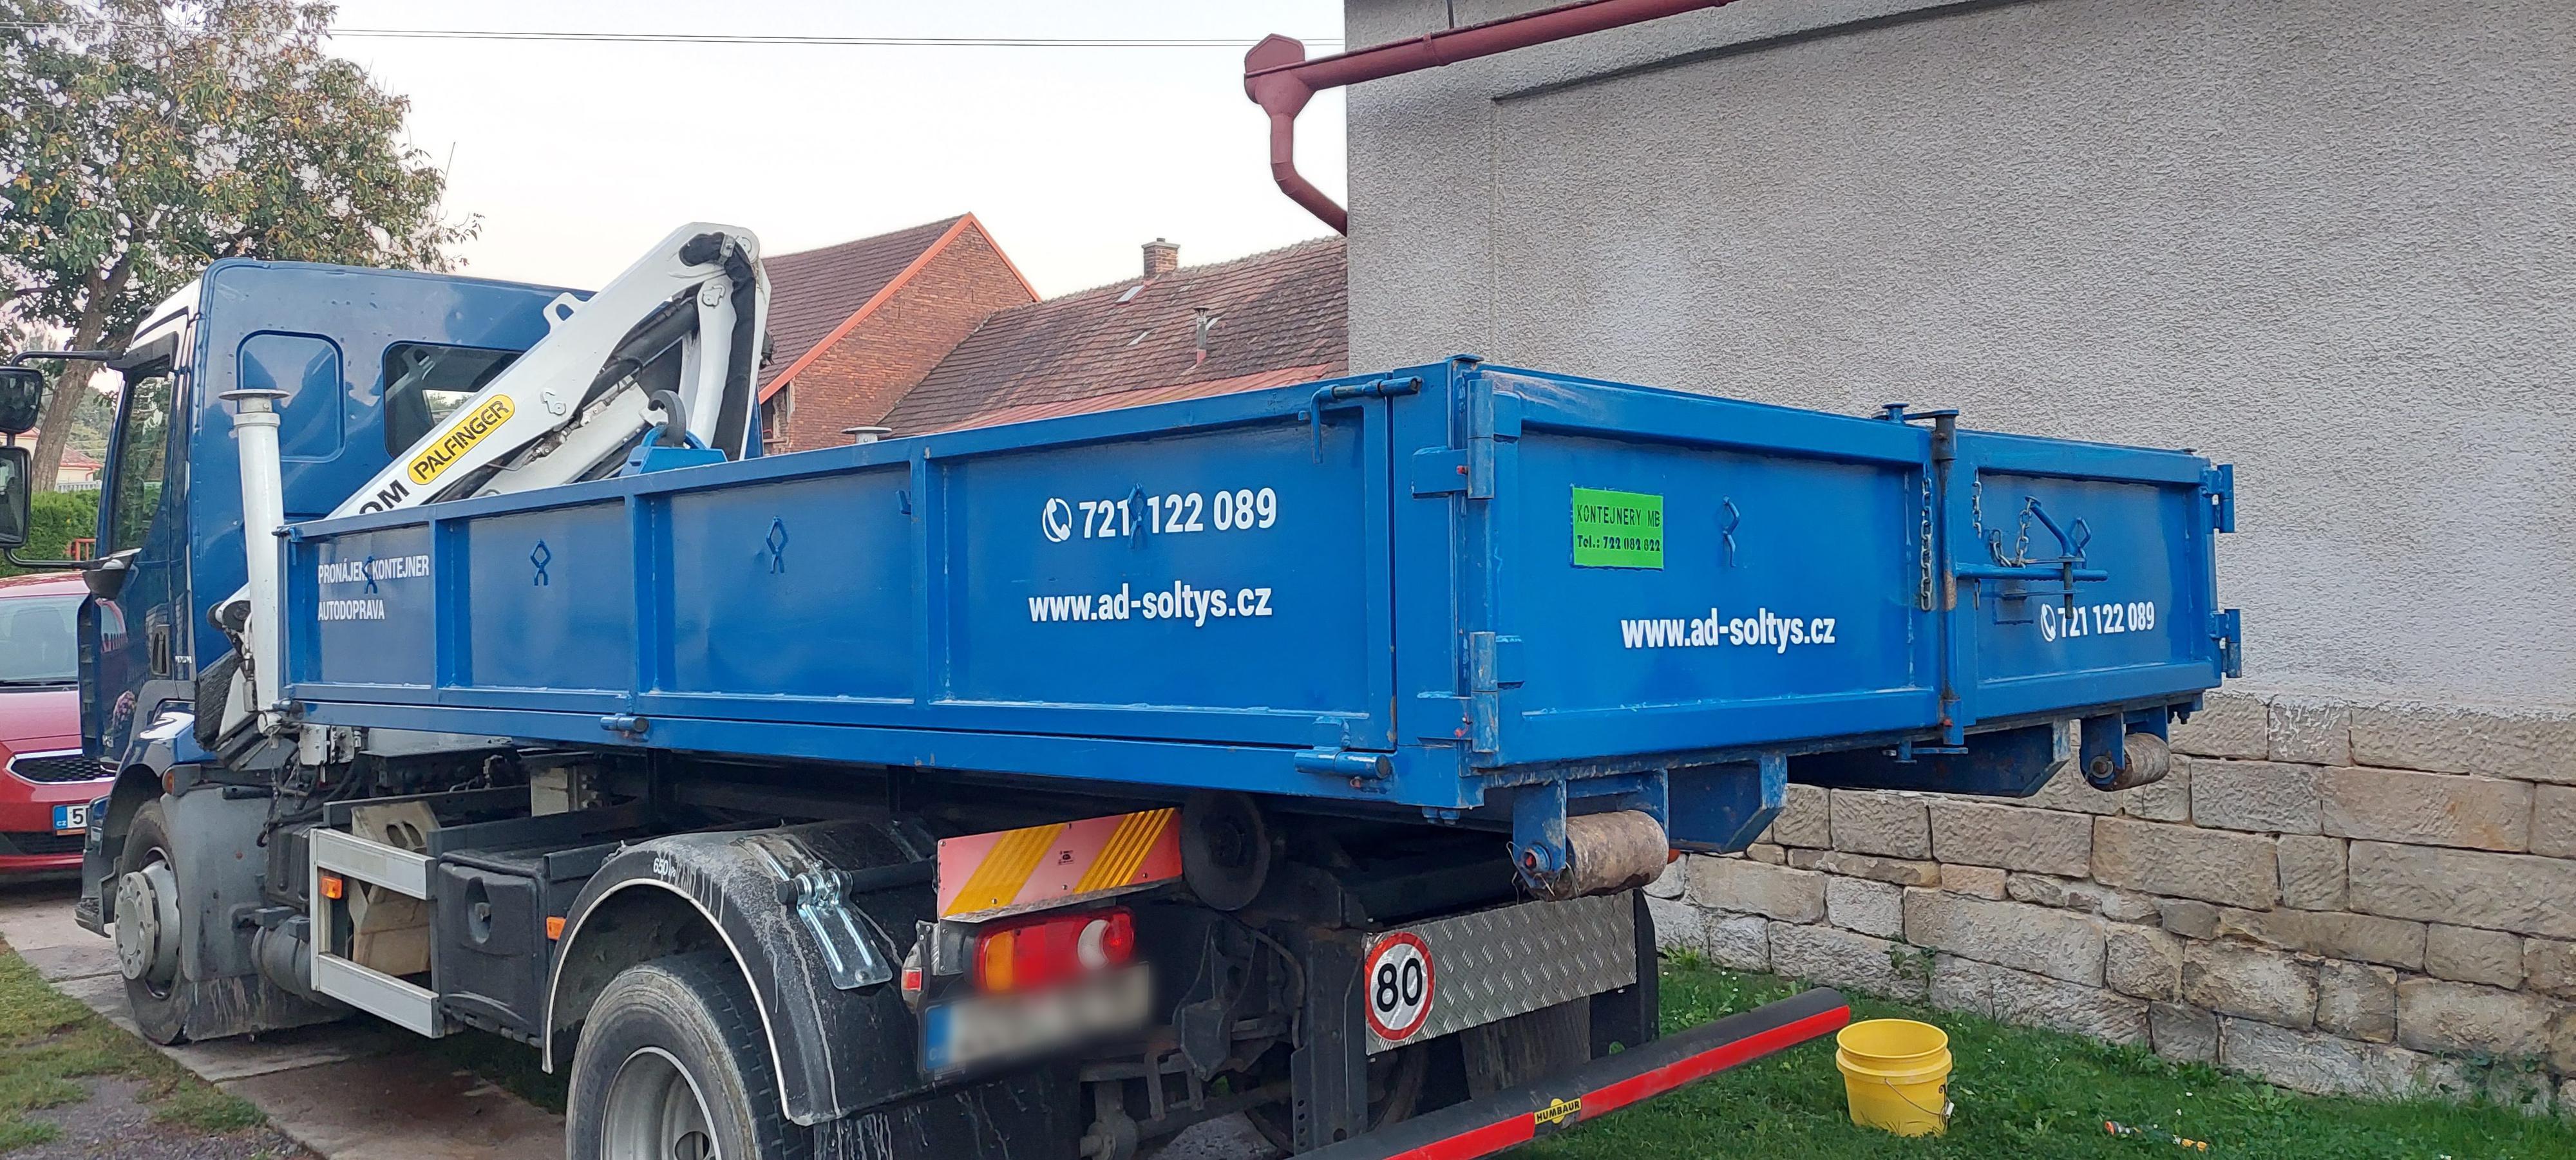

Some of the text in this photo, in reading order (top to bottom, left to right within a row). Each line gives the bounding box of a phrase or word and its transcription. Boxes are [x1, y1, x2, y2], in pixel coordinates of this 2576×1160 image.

[413, 400, 510, 480] PALFINGER
[1079, 487, 1277, 539] 721 122 089
[1577, 504, 1660, 527] KONTEJNERY MB
[1603, 536, 1622, 550] 722
[1624, 538, 1641, 551] 082
[1643, 538, 1660, 552] 822
[372, 555, 430, 581] KONTEJNER
[317, 599, 385, 622] AUTODOPRAVA
[1028, 580, 1273, 628] www.ad-soltys.cz
[1620, 607, 1835, 654] www.ad-soltys.cz
[2057, 601, 2155, 638] 721 122 089
[72, 807, 89, 825] 5
[653, 857, 668, 875] 650
[1376, 957, 1423, 1013] 80
[1536, 1101, 1580, 1122] HUMBAUR
